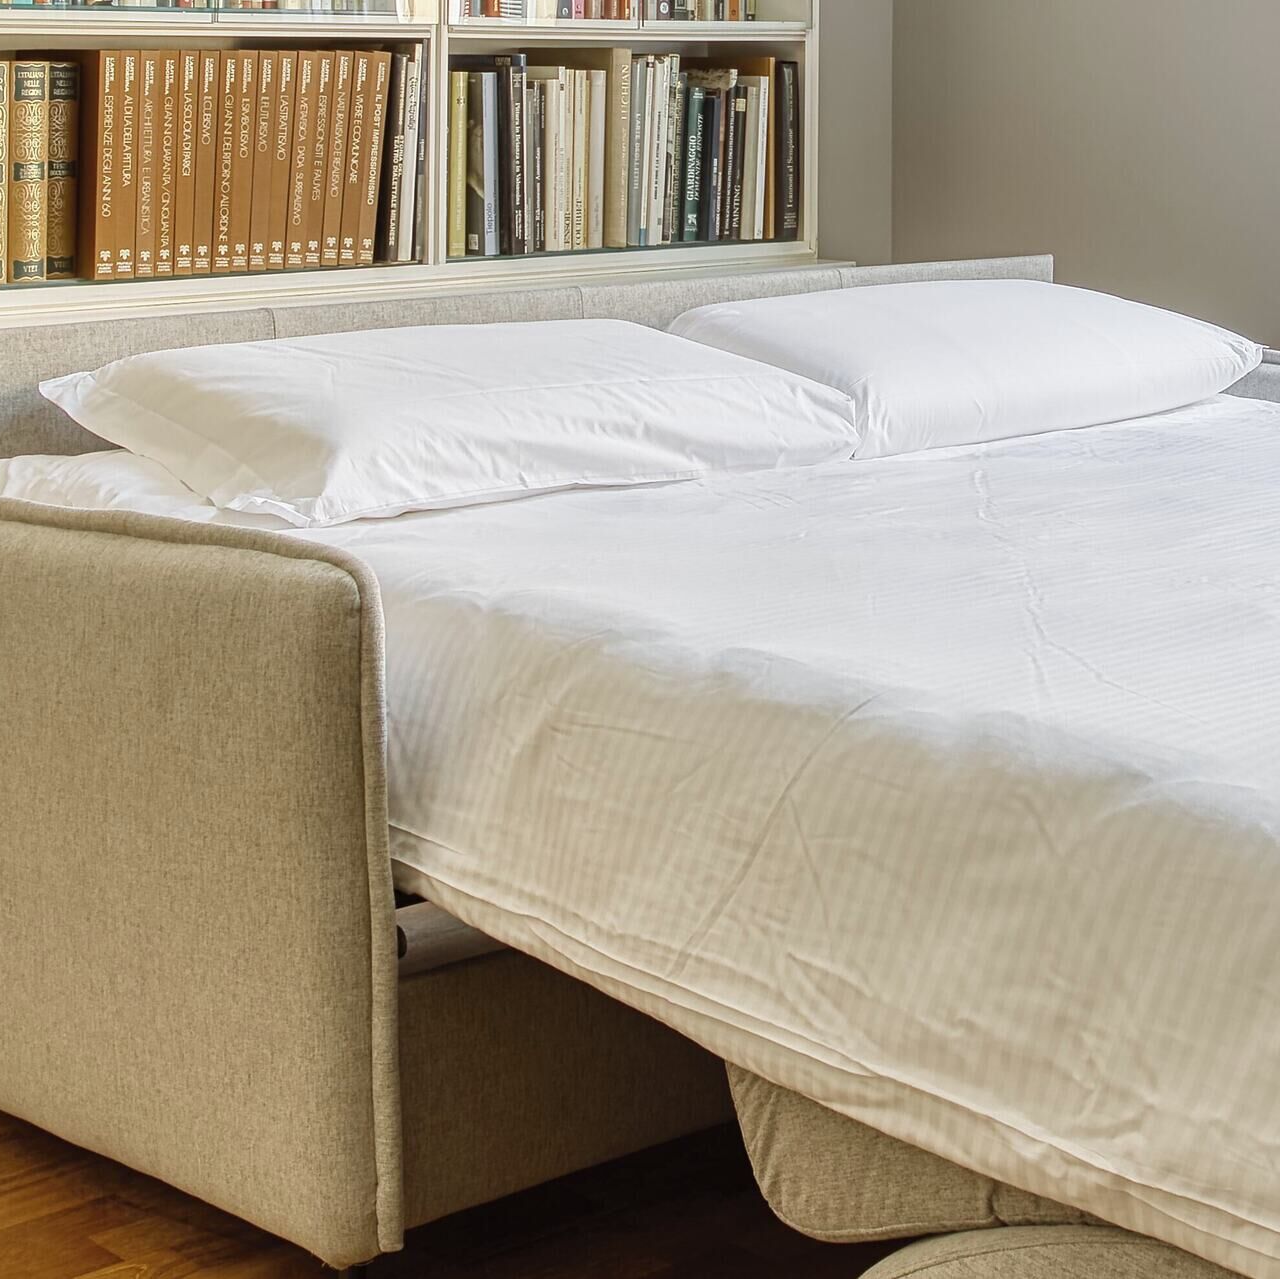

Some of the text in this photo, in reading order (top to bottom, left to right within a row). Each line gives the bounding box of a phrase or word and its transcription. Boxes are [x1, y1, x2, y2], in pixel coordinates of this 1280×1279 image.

[373, 104, 381, 127] POST
[367, 129, 380, 205] IMPRESSIONISMO
[686, 135, 696, 200] GIARDINAGGIO
[486, 203, 494, 235] Tiepolo
[732, 185, 741, 227] PAINTING
